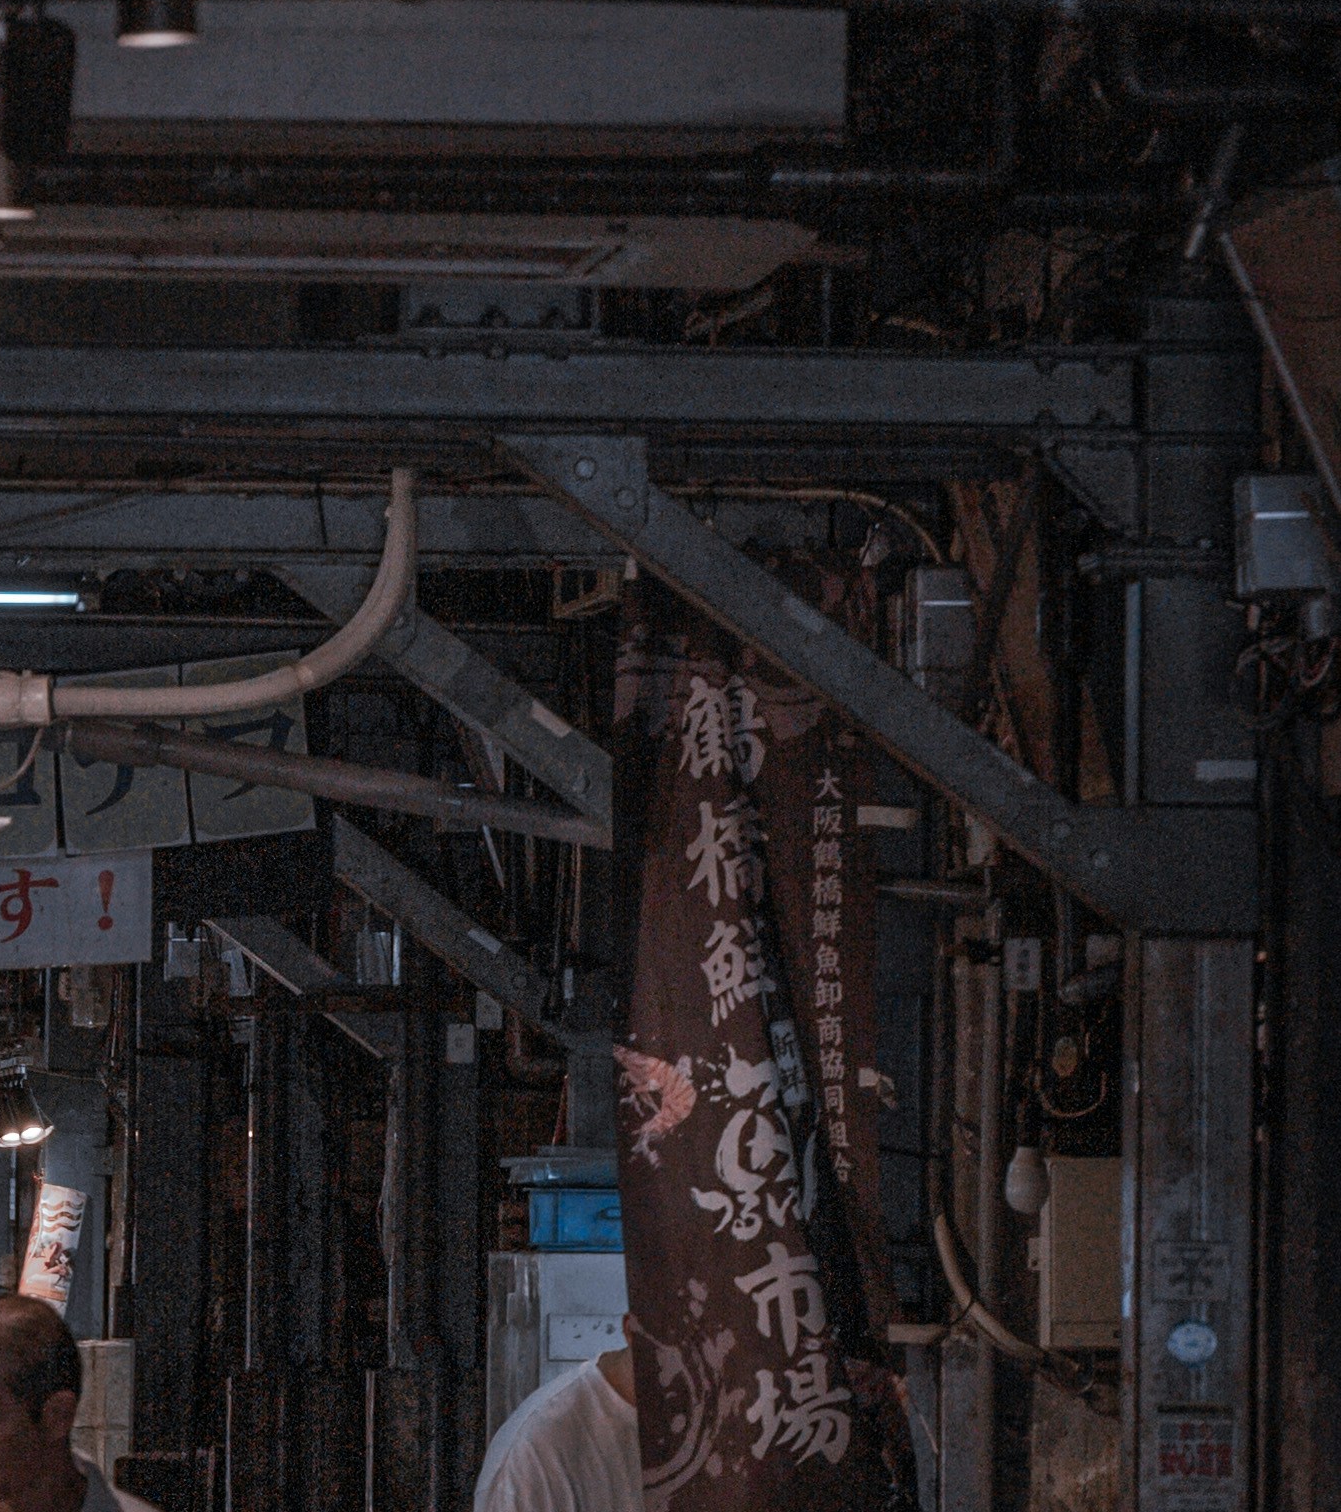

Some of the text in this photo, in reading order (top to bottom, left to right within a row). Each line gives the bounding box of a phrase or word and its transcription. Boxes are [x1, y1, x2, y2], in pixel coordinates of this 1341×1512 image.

[812, 768, 853, 1184] 大阪鶴橋鮮魚卸商協同組合
